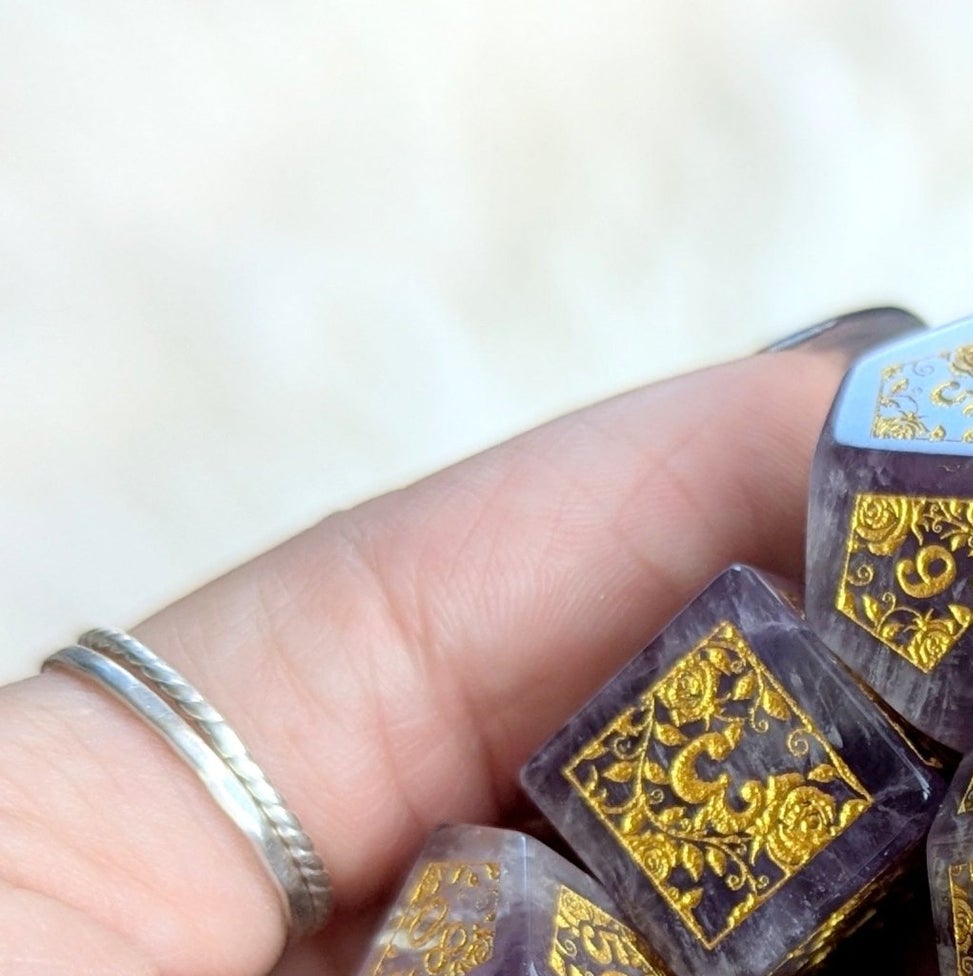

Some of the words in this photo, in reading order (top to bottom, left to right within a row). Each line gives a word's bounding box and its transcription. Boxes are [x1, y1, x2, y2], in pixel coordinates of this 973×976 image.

[897, 545, 956, 598] 9
[670, 731, 762, 830] 3
[408, 899, 467, 976] 80
